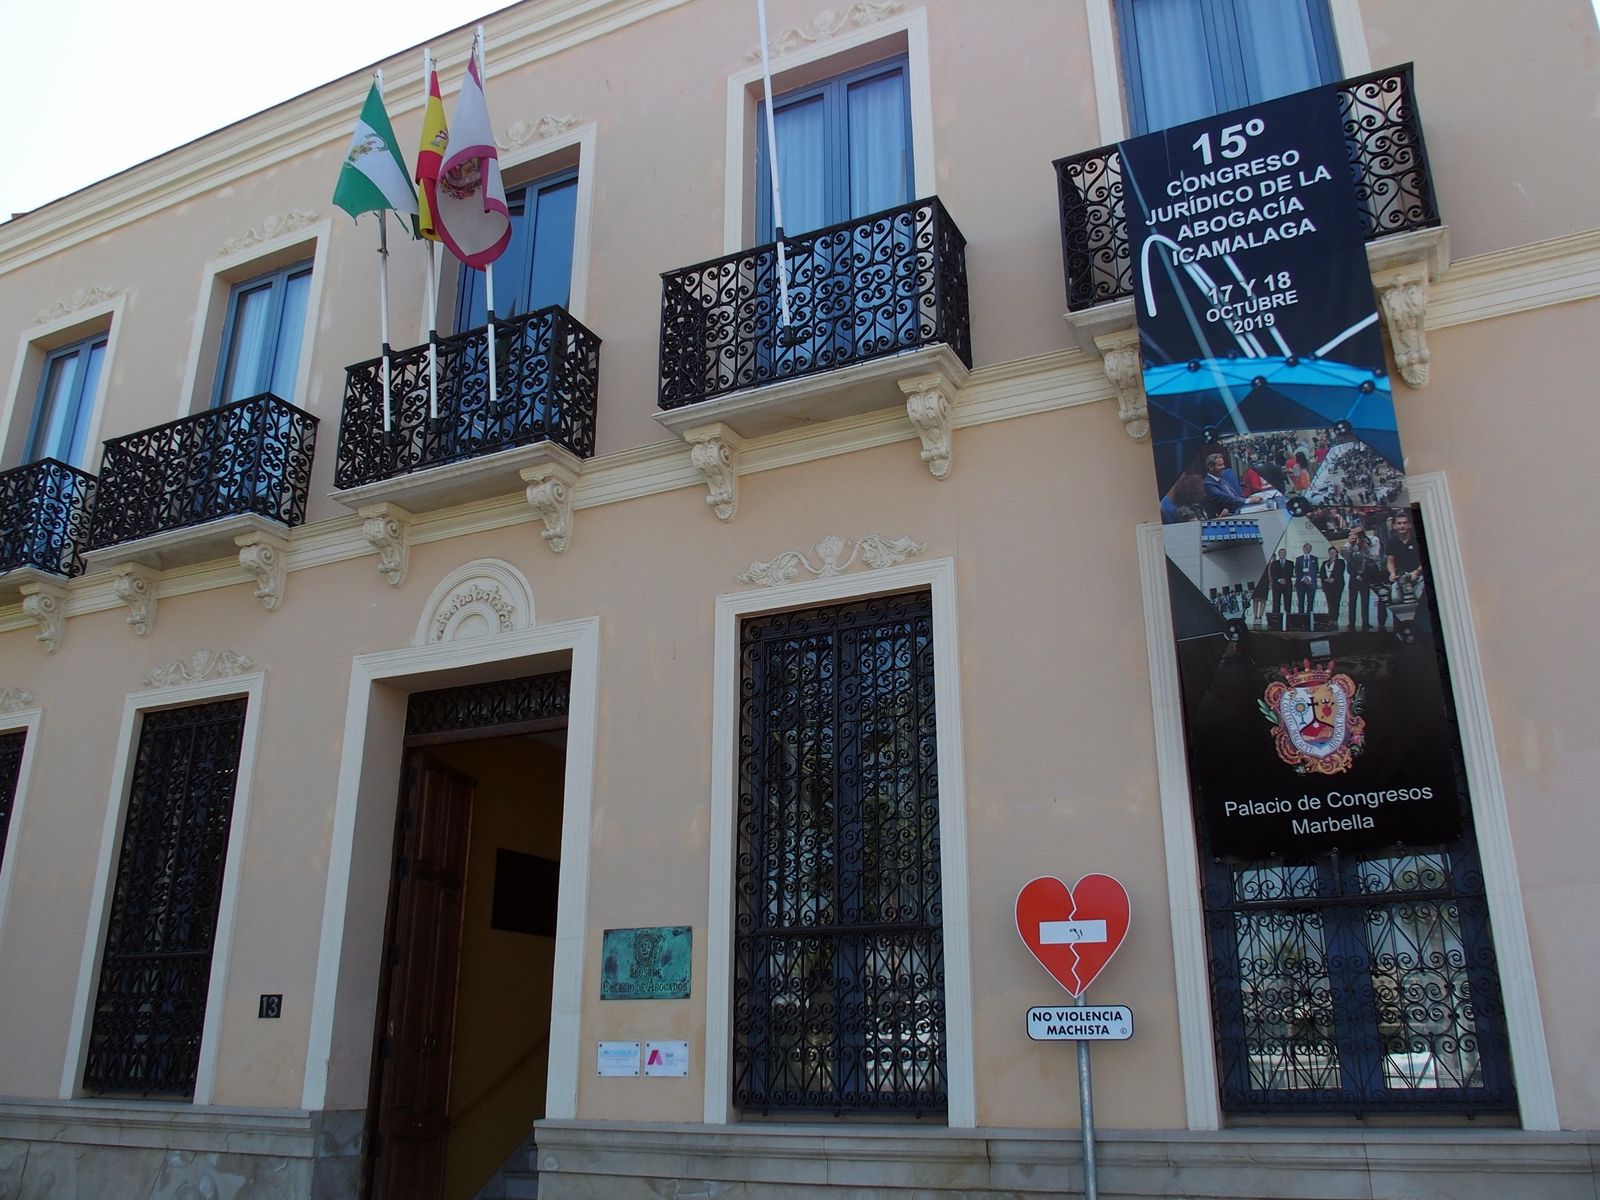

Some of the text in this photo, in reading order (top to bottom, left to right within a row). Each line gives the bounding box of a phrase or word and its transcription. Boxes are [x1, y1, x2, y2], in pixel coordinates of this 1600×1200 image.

[1167, 149, 1300, 198] CONGRESO
[1145, 164, 1332, 226] JURÍDICO DE LA
[1177, 196, 1304, 242] ABOGACÍA
[1172, 217, 1316, 266] ICAMALAGA
[1208, 271, 1292, 305] 17 Y 18
[1206, 289, 1299, 324] OCTUBRE
[1233, 312, 1275, 335] 2019
[1224, 786, 1433, 817] Palacio de Congresos
[1291, 814, 1375, 835] Marbella
[262, 996, 279, 1017] 13
[1032, 1011, 1123, 1022] NO VIOLENCIA
[1046, 1025, 1110, 1036] MACHISTA
